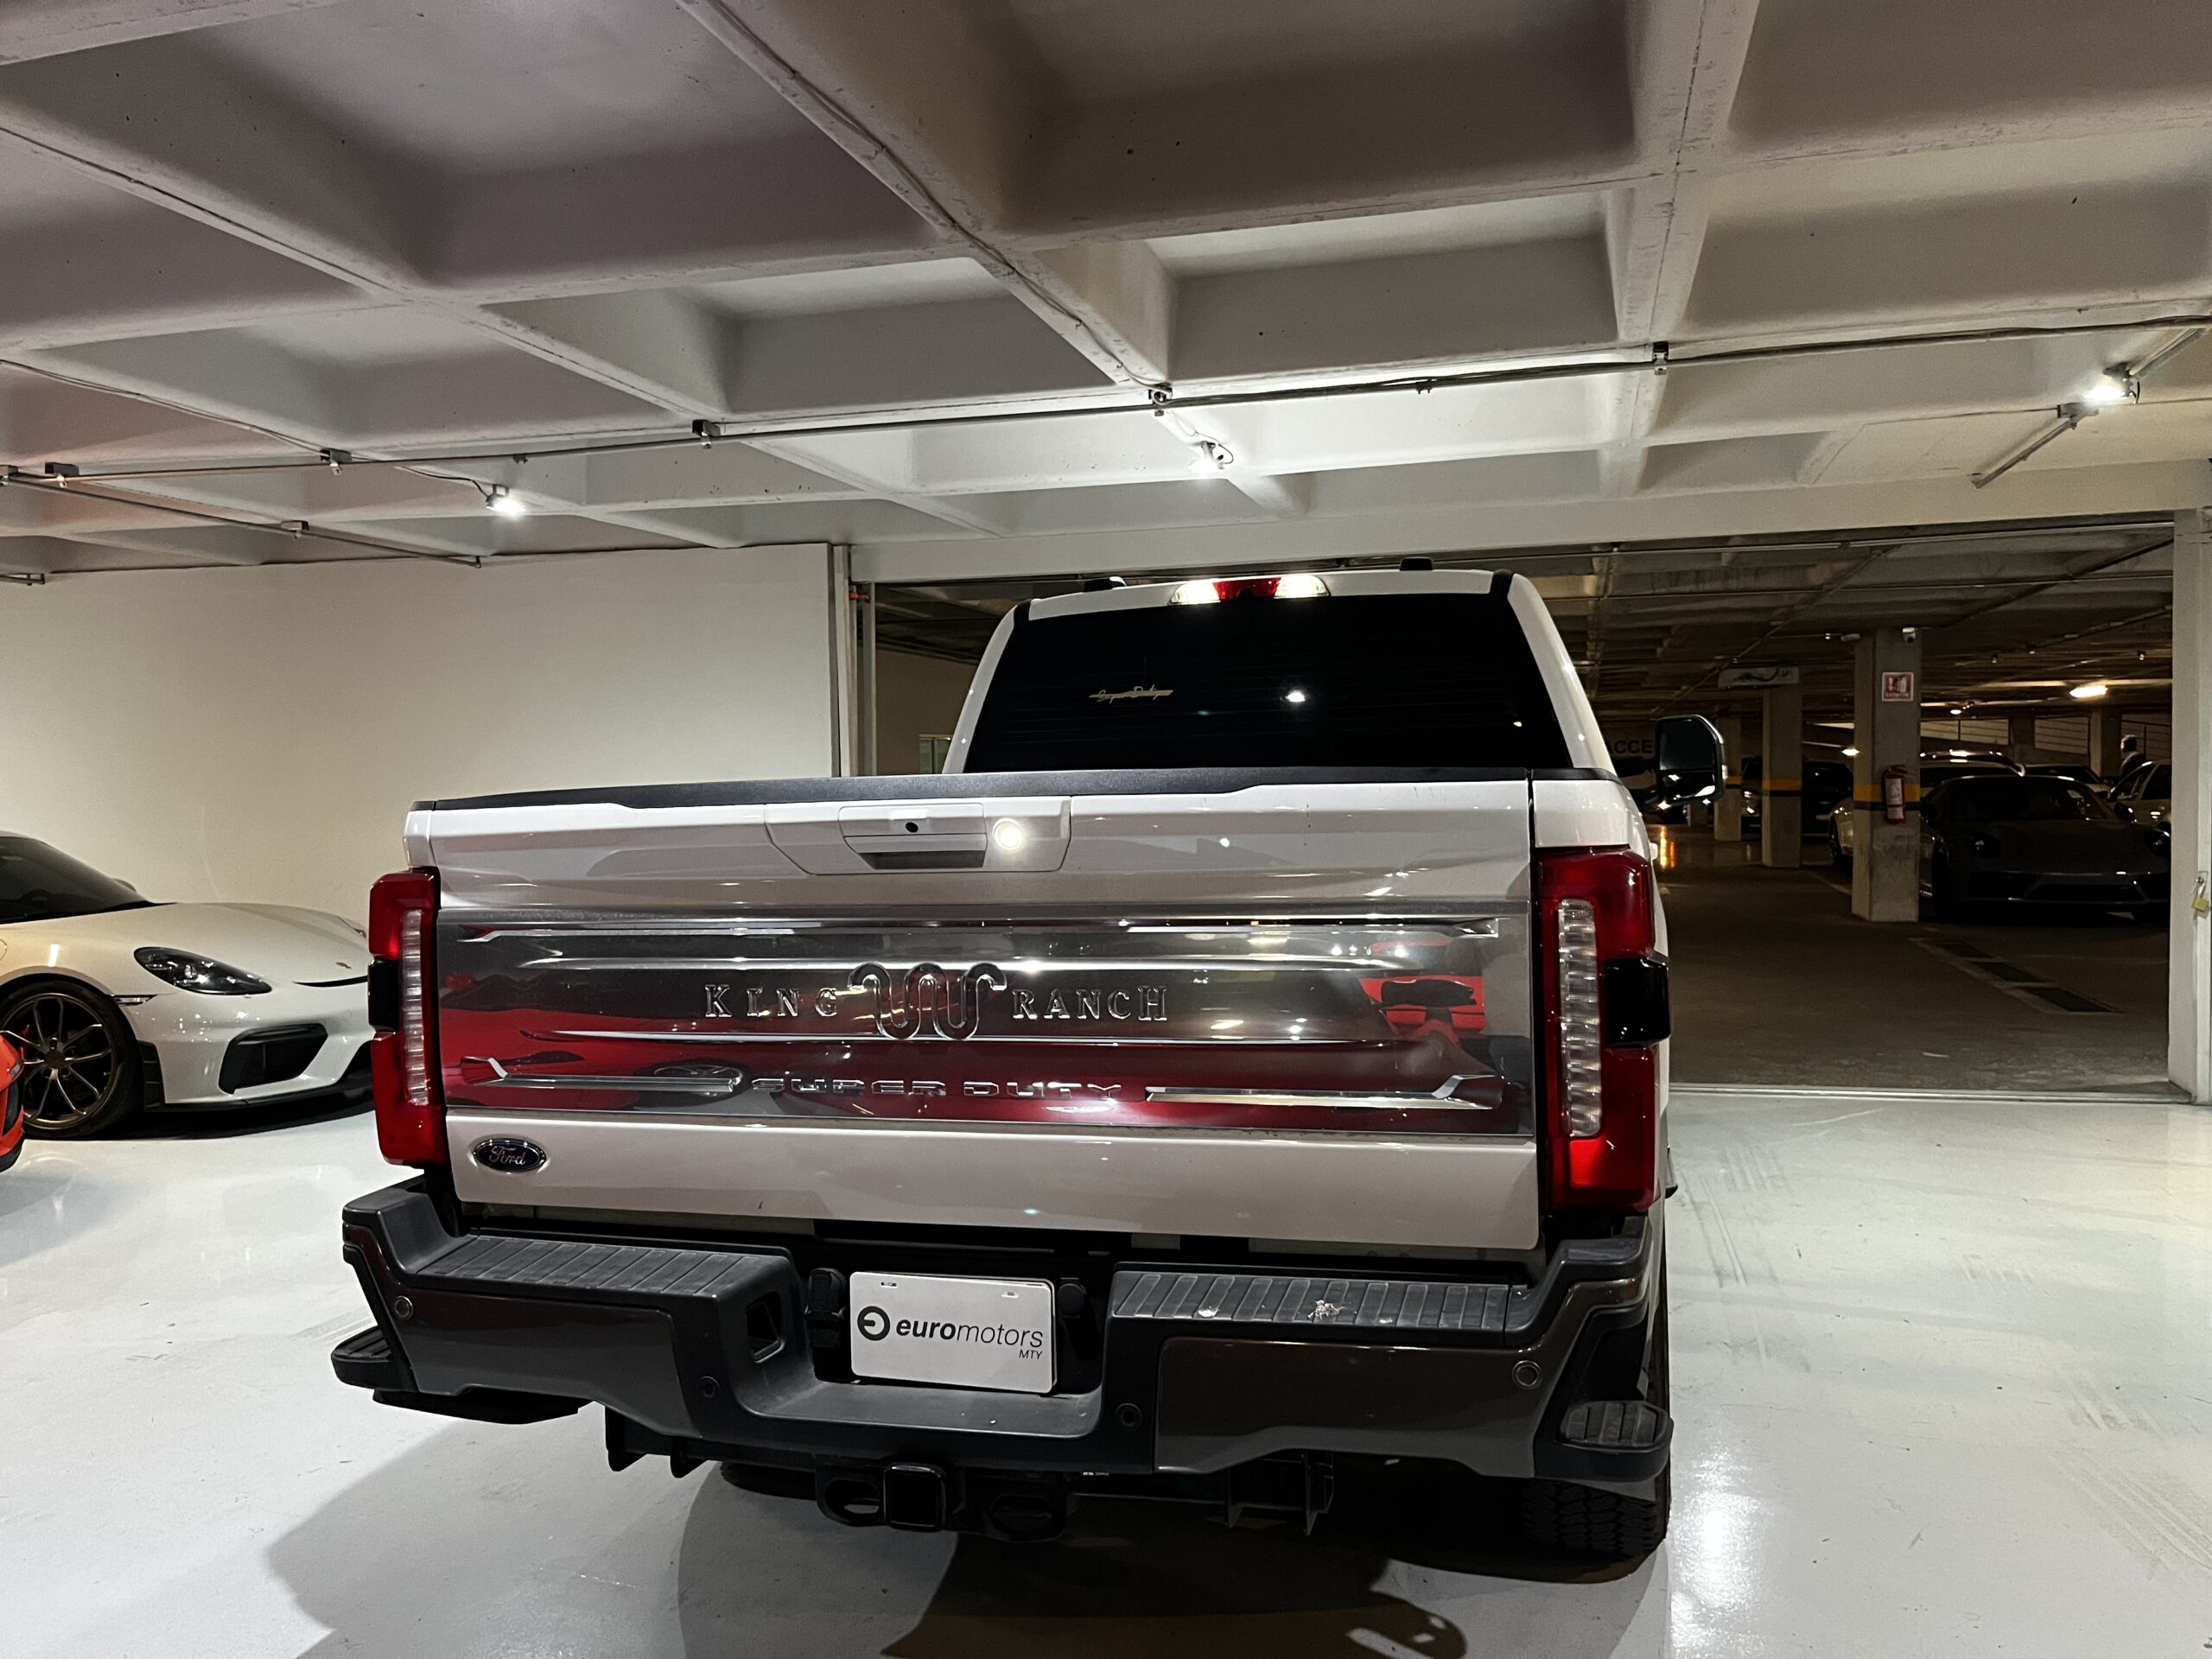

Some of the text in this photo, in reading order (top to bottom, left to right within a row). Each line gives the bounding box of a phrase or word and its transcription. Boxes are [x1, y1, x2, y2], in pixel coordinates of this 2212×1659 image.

[704, 983, 1168, 1021] KING RANCH
[751, 1077, 1122, 1101] SUPER DUTY
[489, 1145, 526, 1166] Ford
[896, 1319, 1044, 1348] euromotors
[1019, 1349, 1043, 1360] MTY
